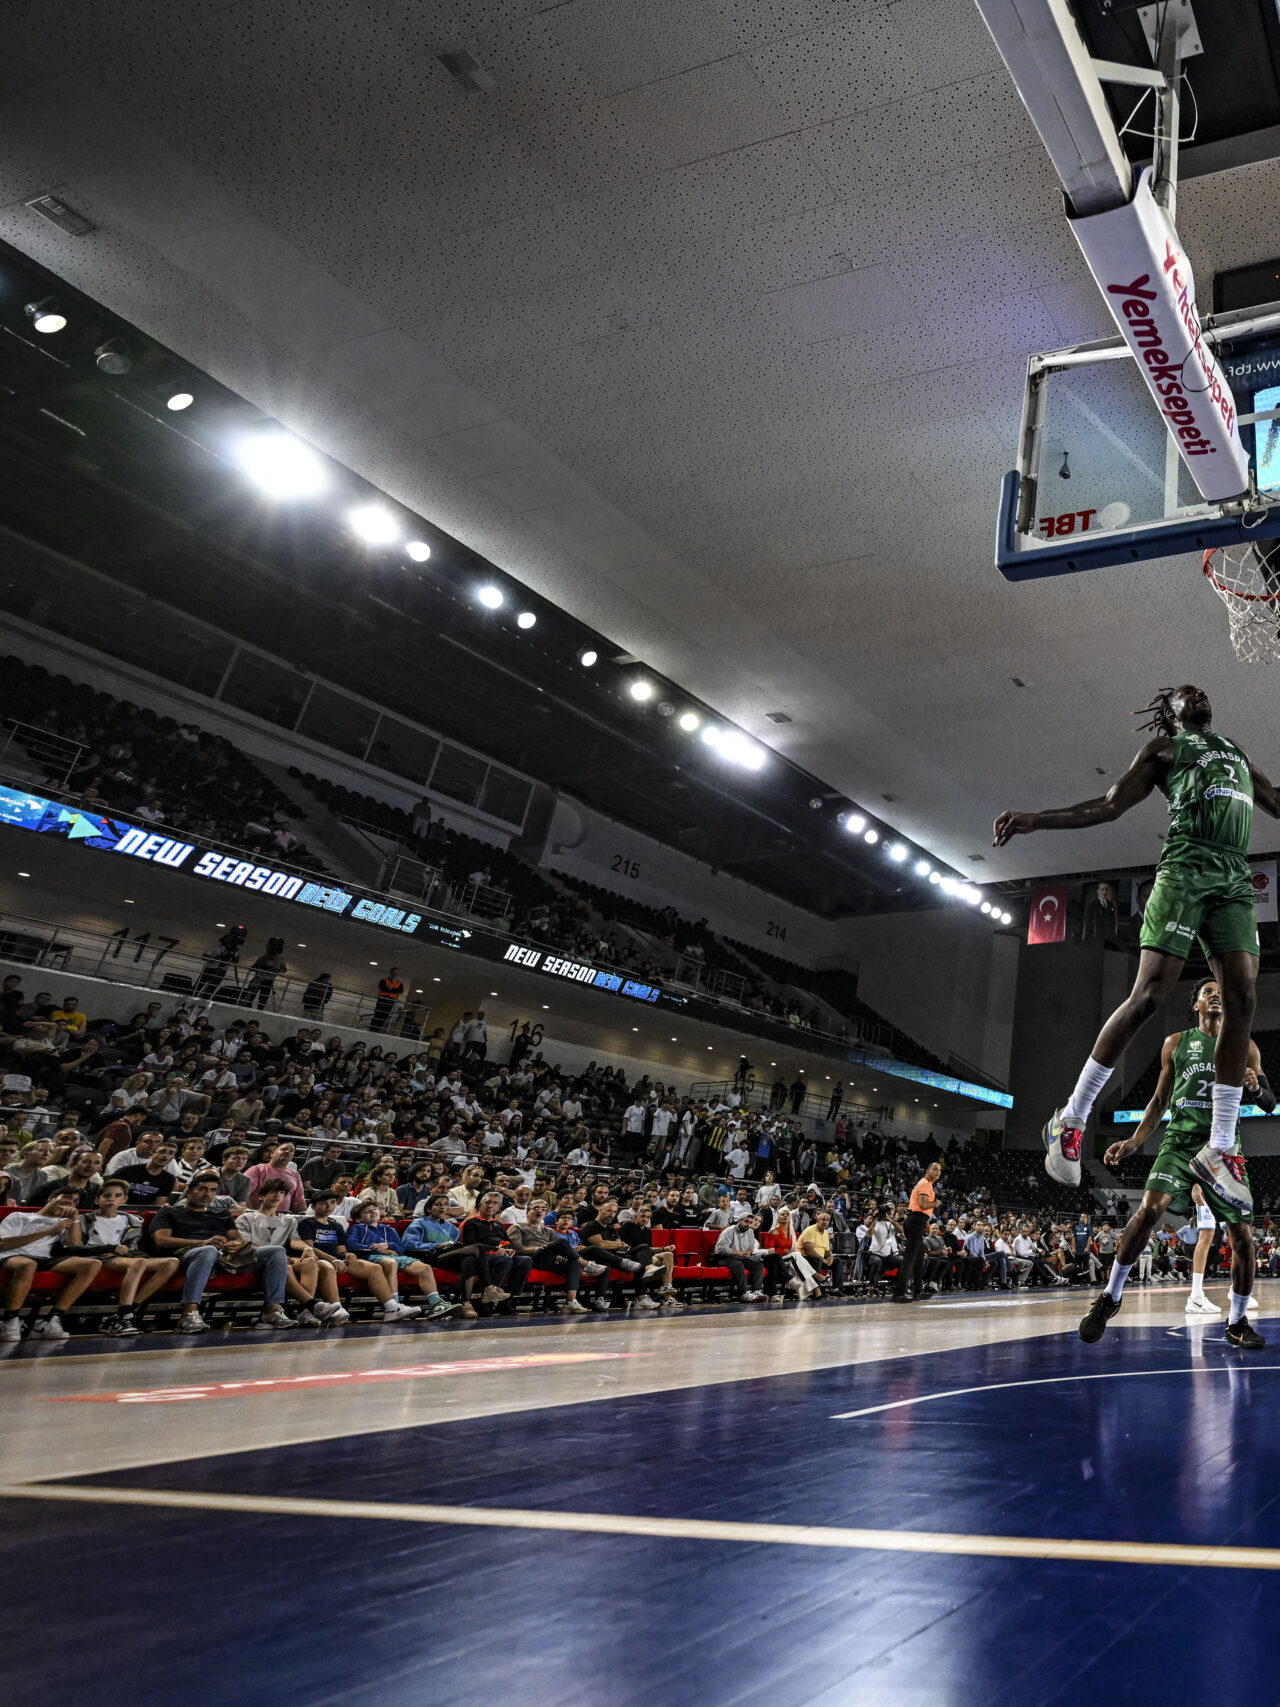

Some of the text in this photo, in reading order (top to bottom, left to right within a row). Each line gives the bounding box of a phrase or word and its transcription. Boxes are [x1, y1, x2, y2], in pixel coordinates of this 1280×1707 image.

[1107, 273, 1217, 457] Yemeksepeti
[1223, 764, 1239, 784] 2
[112, 827, 197, 869] NEW
[193, 851, 304, 900] SEASON
[296, 881, 353, 914] NEW
[611, 854, 640, 880] 215
[766, 920, 787, 941] 214
[112, 927, 180, 969] 117
[503, 944, 542, 968] NEW
[541, 955, 597, 985] SEASON
[1196, 1080, 1216, 1097] 21
